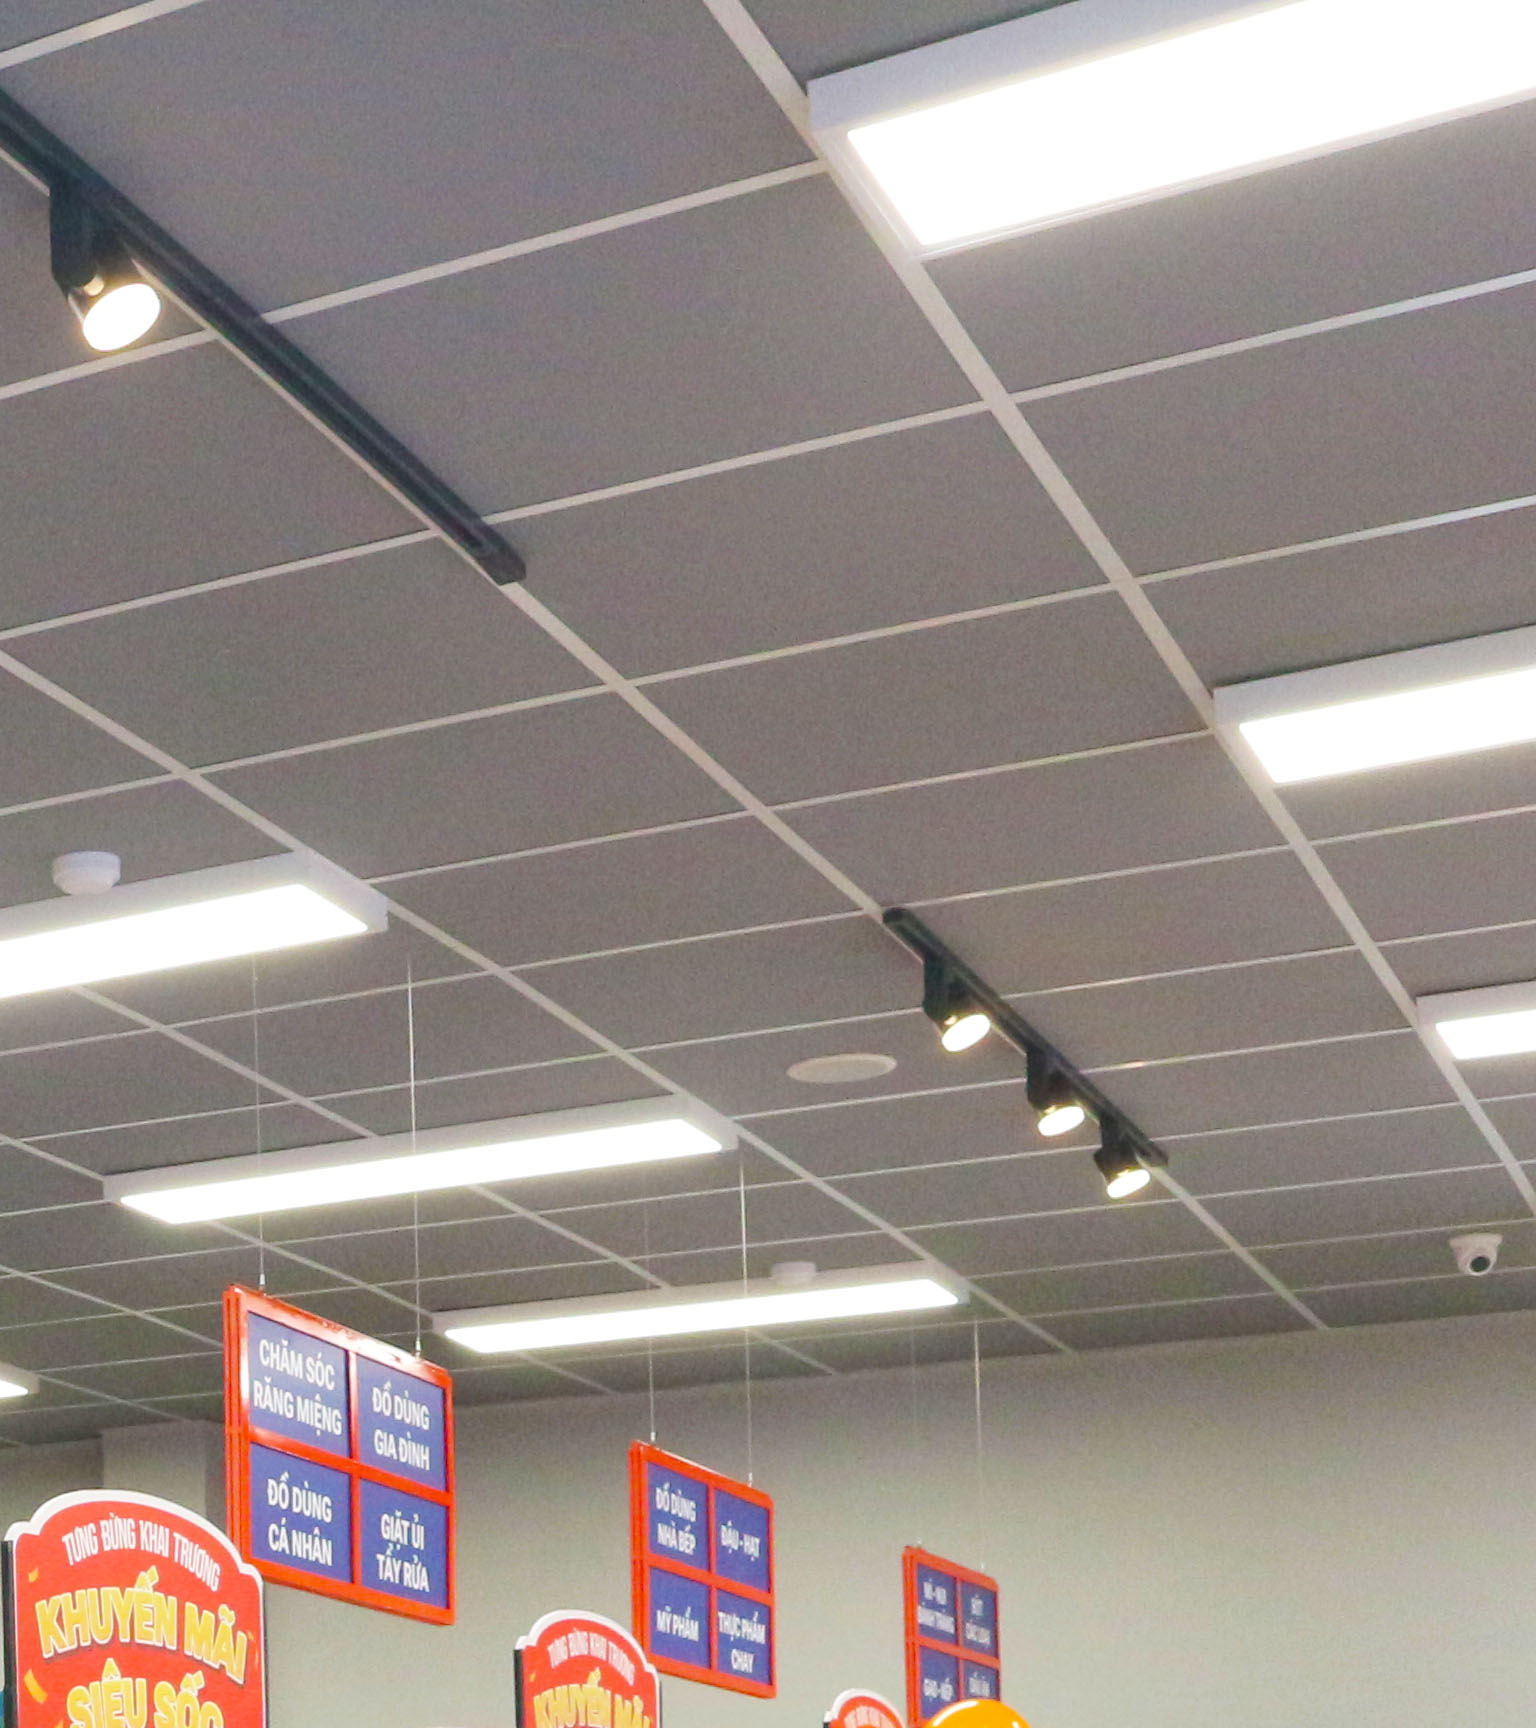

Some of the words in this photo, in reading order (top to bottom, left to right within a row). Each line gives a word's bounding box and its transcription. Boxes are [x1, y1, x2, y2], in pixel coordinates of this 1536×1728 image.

[259, 1339, 302, 1379] CHĂM
[306, 1352, 335, 1390] SÓC
[254, 1374, 294, 1418] RĂNG
[297, 1393, 342, 1438] MIỆNG
[372, 1380, 392, 1415] ĐỒ
[394, 1389, 430, 1430] DÙNG
[374, 1430, 397, 1457] GIA
[400, 1434, 430, 1470] ĐÌNH
[267, 1471, 290, 1506] ĐỒ
[292, 1480, 332, 1523] DÙNG
[268, 1519, 290, 1552] CÁ
[292, 1526, 332, 1566] NHÂN
[381, 1508, 409, 1548] GIẶT
[35, 1565, 178, 1658] KHUYẾN
[184, 1602, 248, 1684] MÃI
